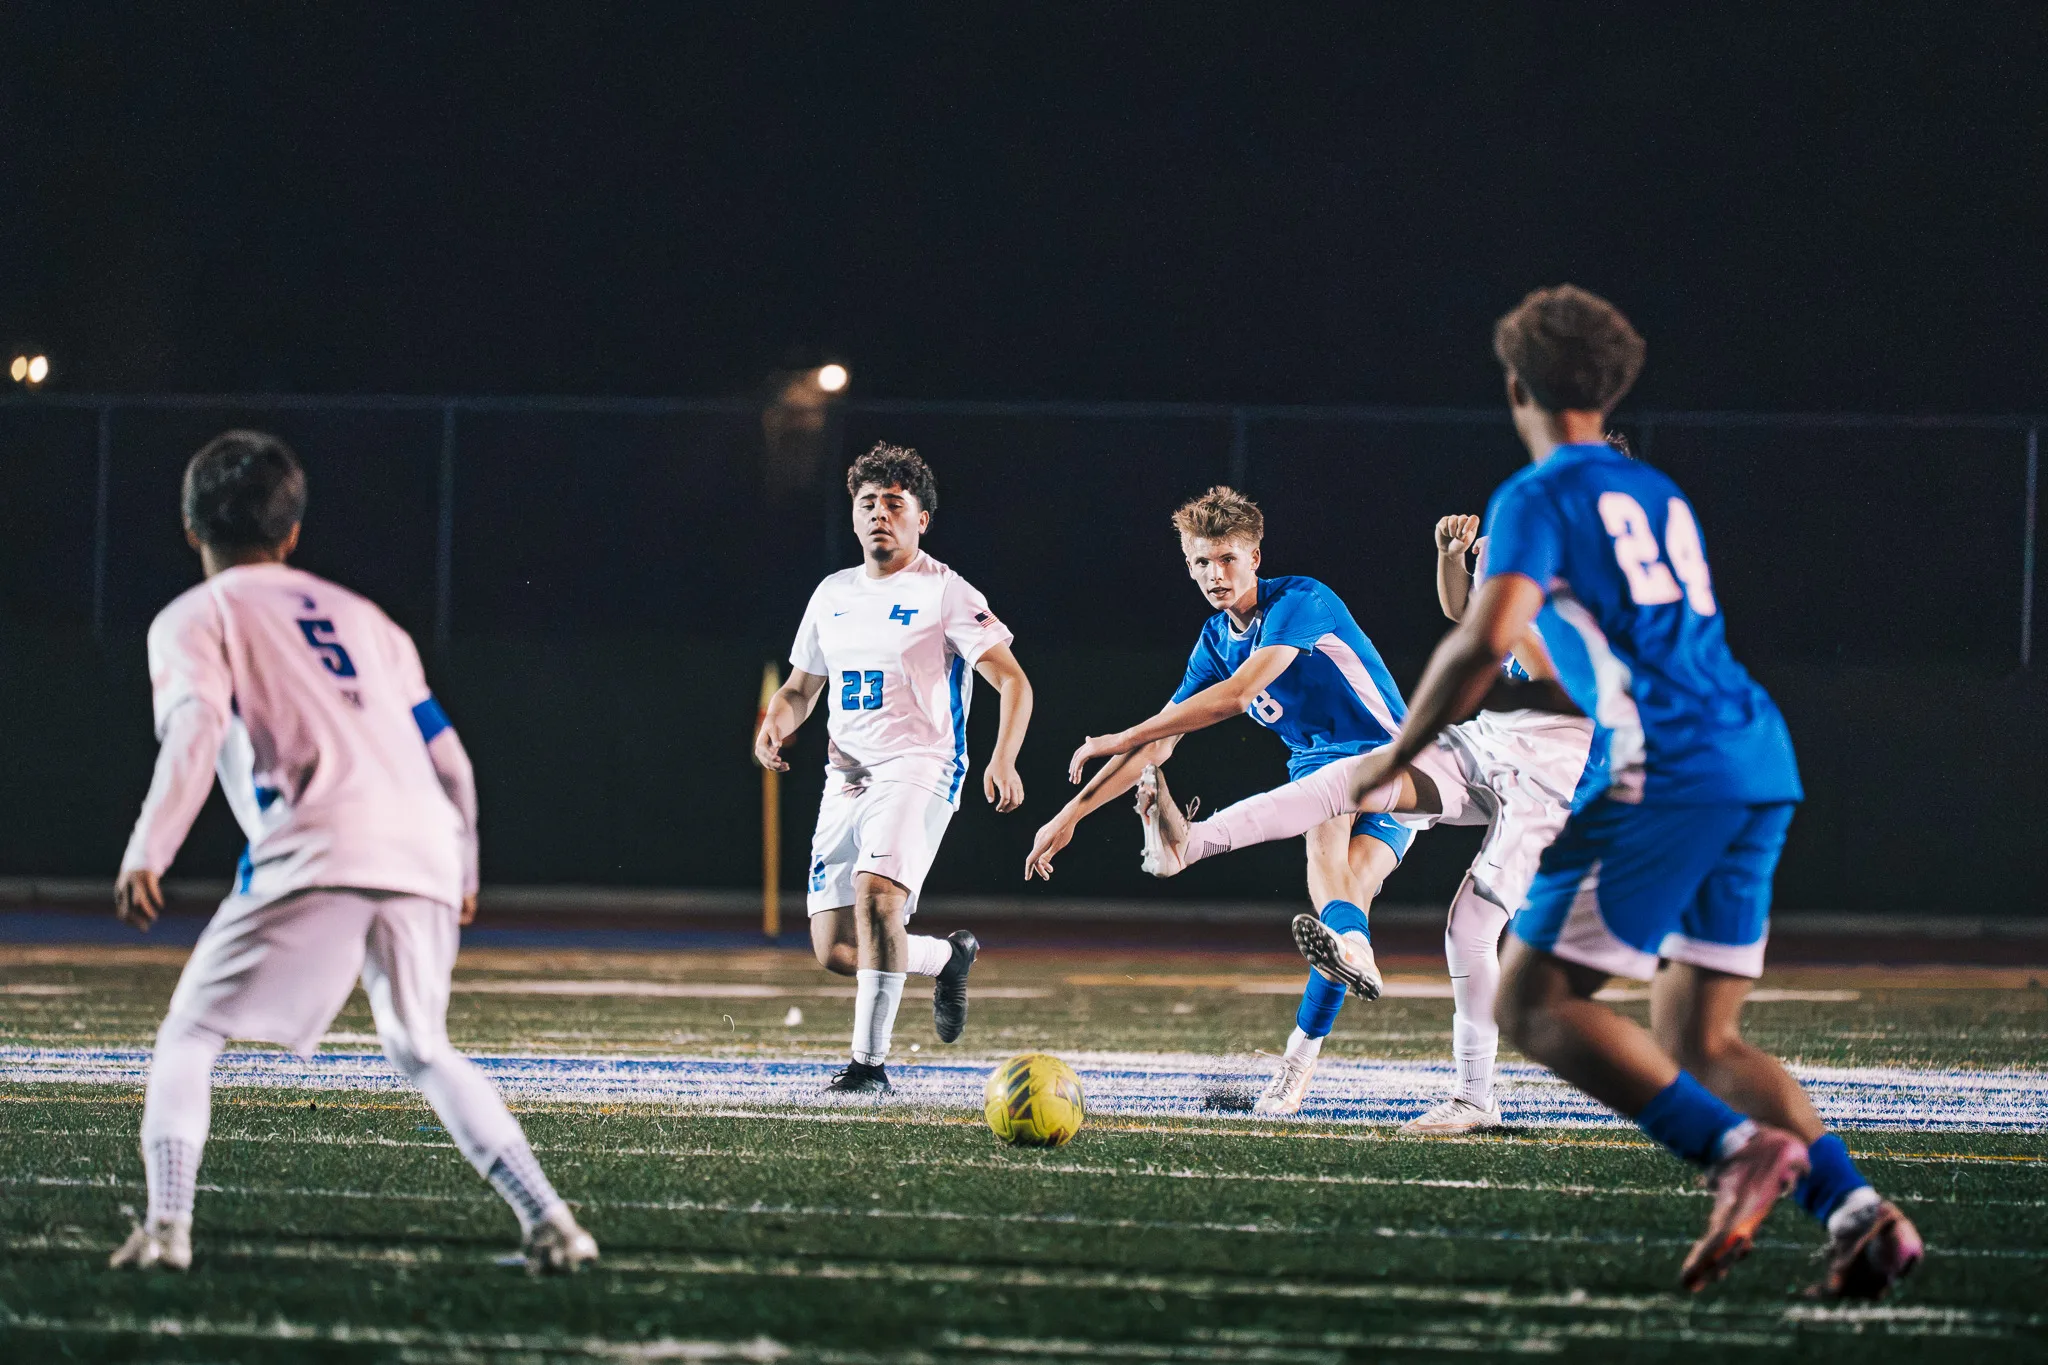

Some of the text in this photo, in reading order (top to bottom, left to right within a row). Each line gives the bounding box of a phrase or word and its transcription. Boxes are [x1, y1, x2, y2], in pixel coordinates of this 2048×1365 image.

[1598, 491, 1716, 617] 24
[889, 604, 919, 626] LT
[296, 618, 357, 678] 5
[842, 670, 884, 711] 23
